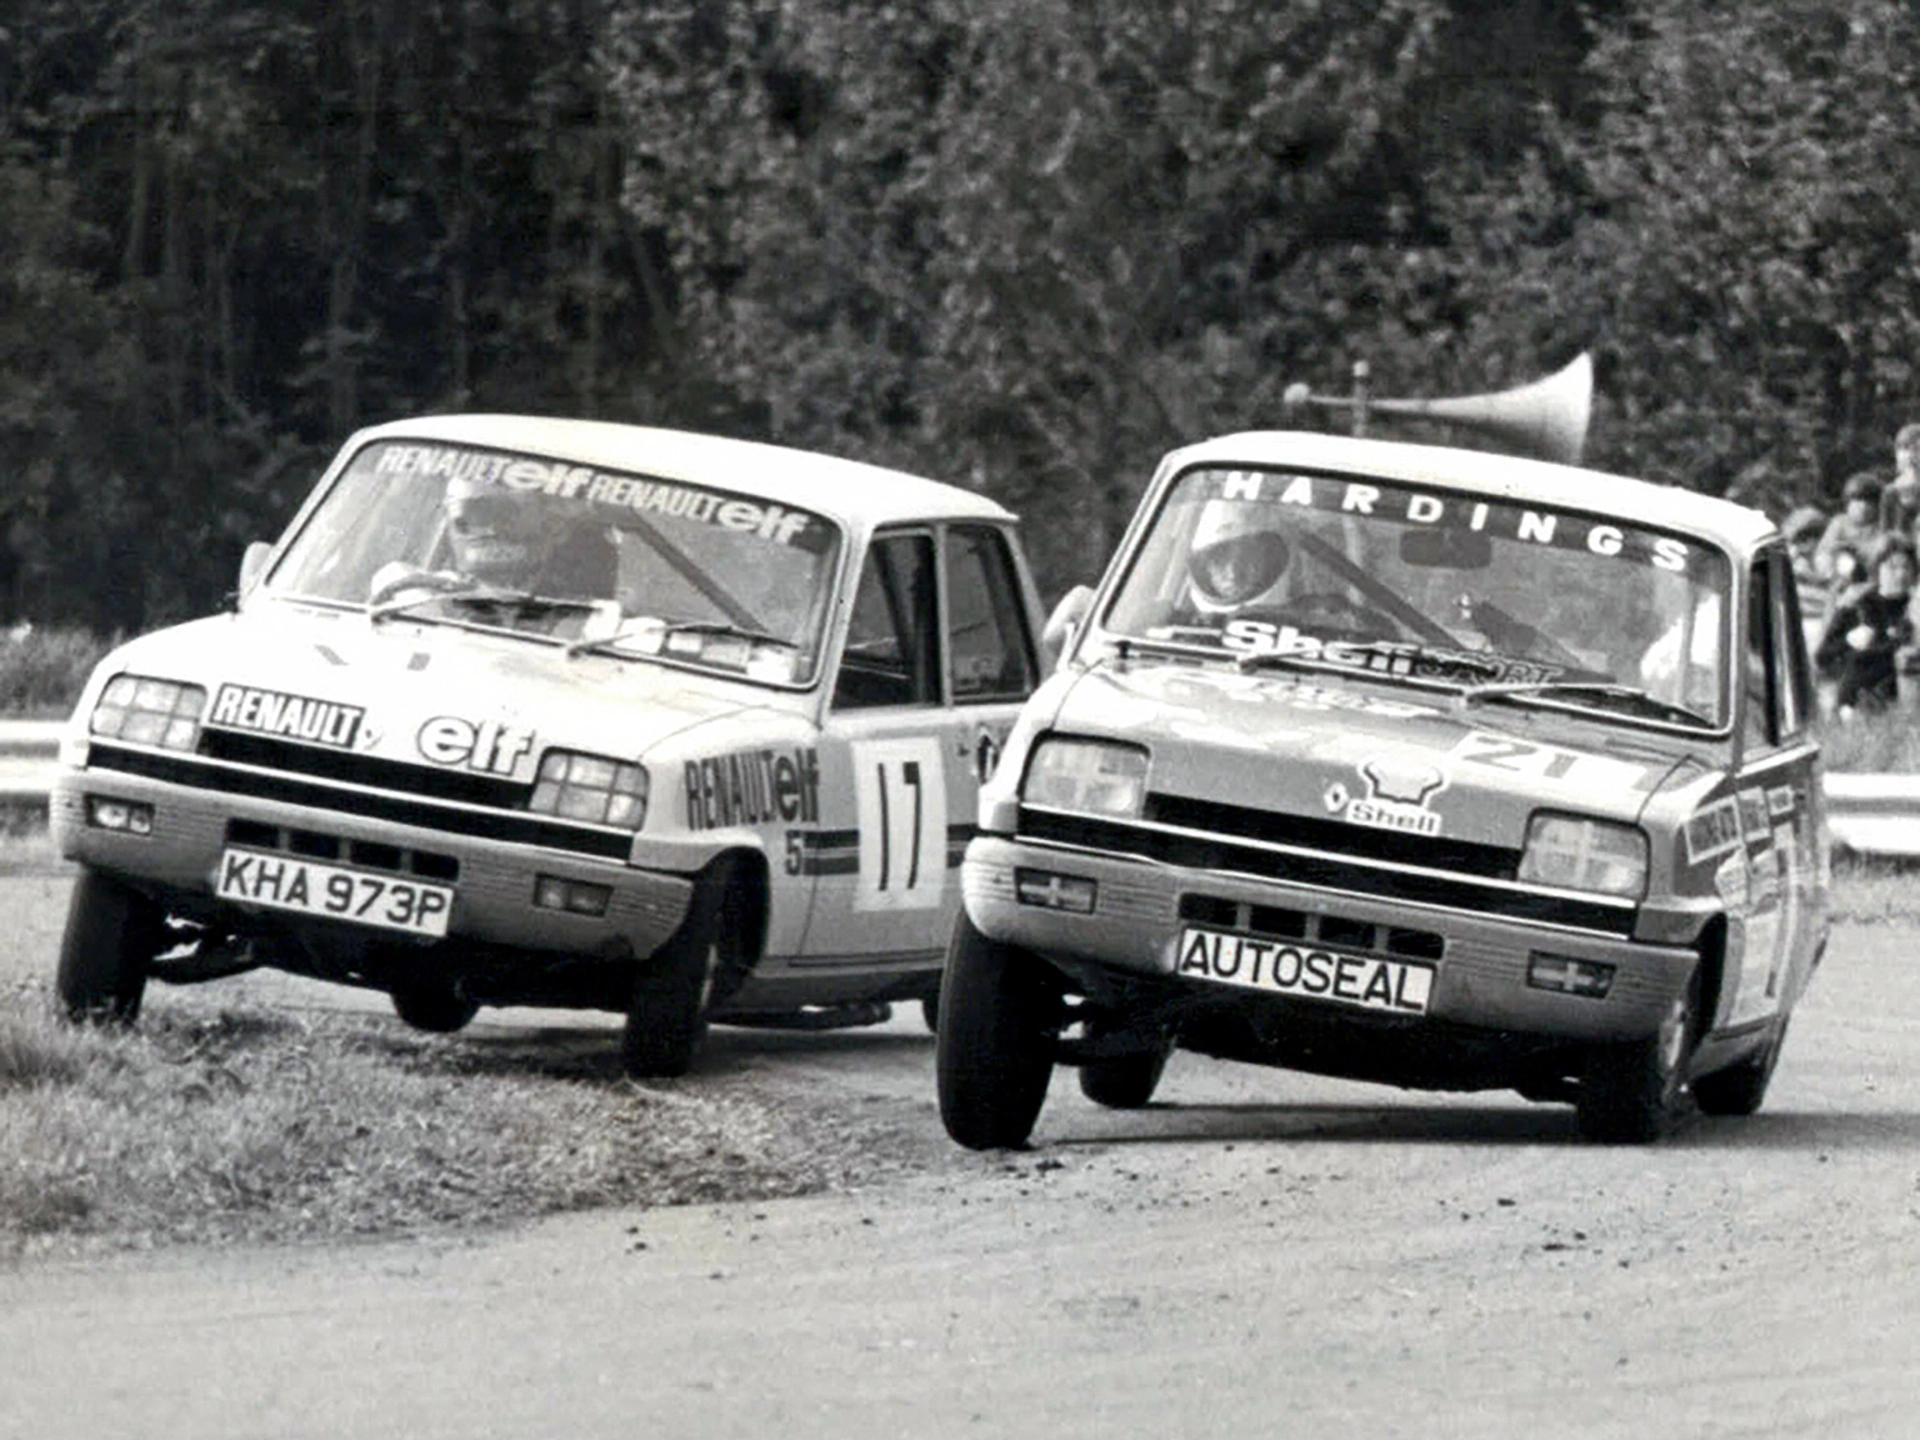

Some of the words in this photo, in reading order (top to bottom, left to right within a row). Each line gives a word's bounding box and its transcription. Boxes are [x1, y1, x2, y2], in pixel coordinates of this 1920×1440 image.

[375, 446, 512, 486] RENAULT
[502, 461, 593, 499] elf
[587, 474, 725, 524] RENAULT
[717, 501, 809, 544] elf
[1223, 470, 1690, 573] HARDINGS
[212, 687, 363, 747] RENAULT
[416, 715, 536, 777] elf
[775, 747, 820, 823] elf
[1462, 736, 1579, 779] 21
[784, 830, 801, 877] 5
[876, 761, 922, 892] 17
[1351, 801, 1438, 834] Shell
[220, 851, 310, 909] KHA
[325, 872, 448, 929] 973P
[1181, 932, 1424, 1012] AUTOSEAL
